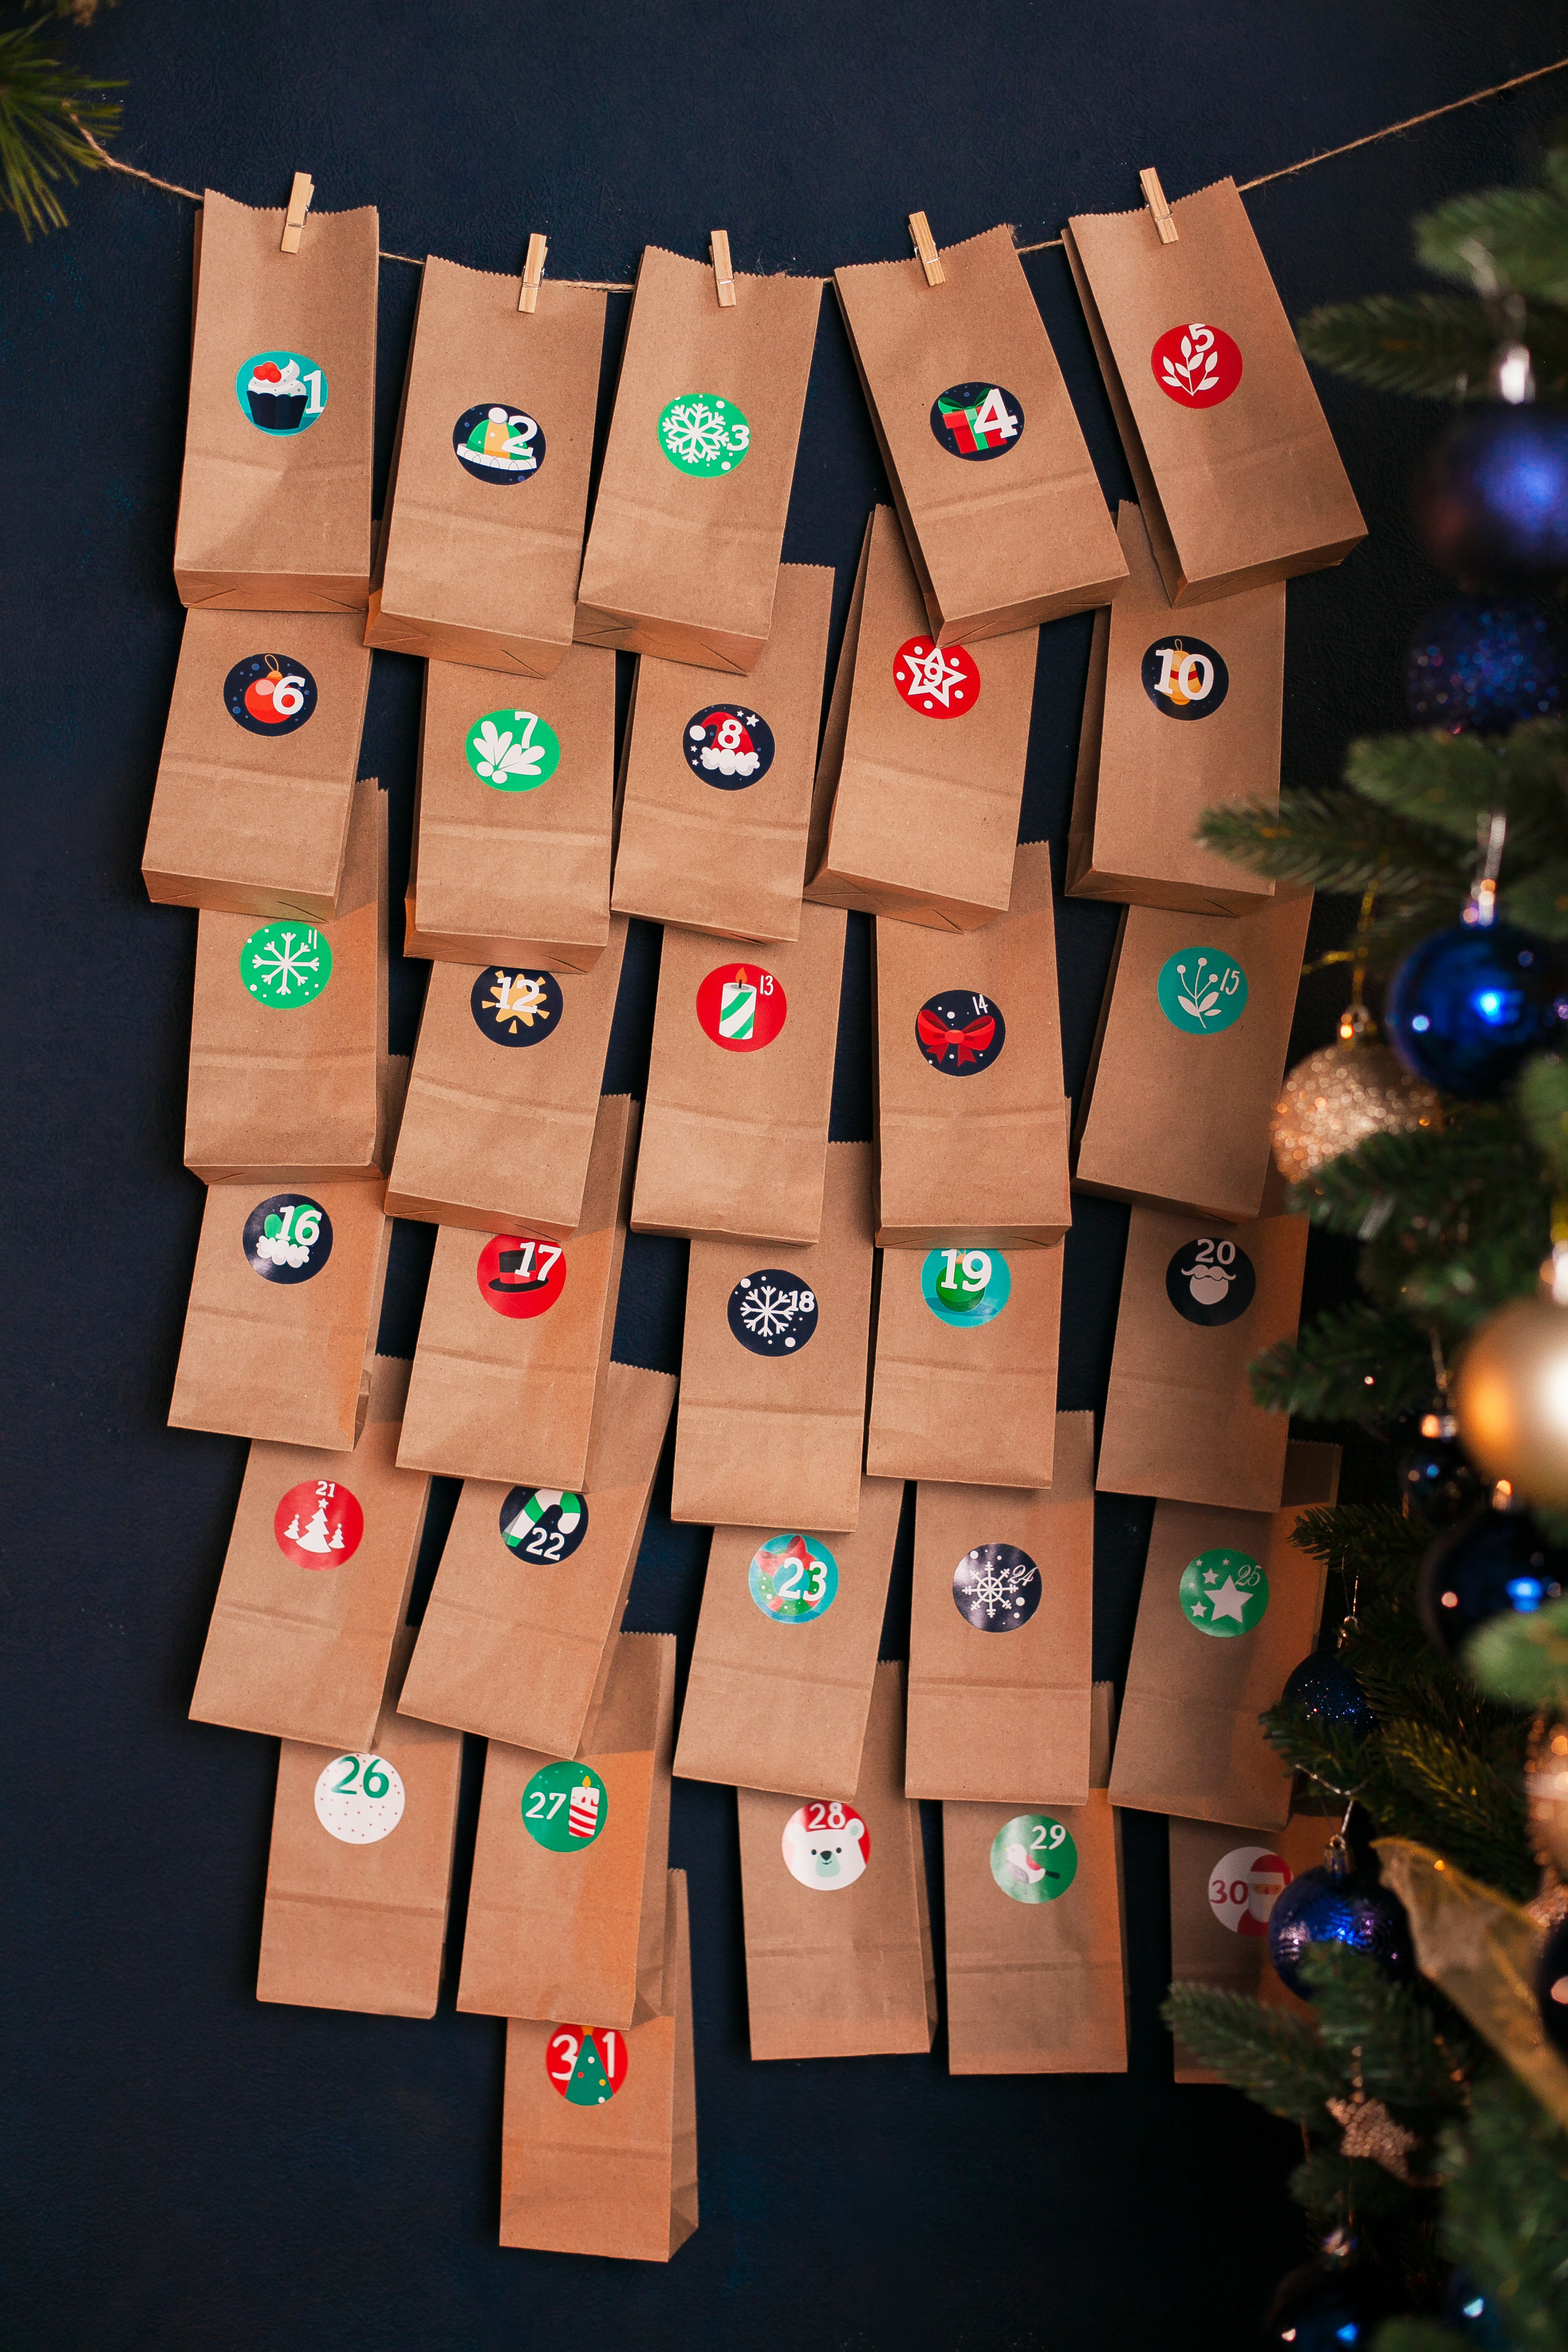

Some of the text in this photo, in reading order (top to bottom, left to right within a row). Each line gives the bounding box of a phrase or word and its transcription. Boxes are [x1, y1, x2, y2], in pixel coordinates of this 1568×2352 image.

[1188, 323, 1214, 353] 5
[303, 370, 325, 414] 1
[973, 389, 1018, 439] 4
[501, 415, 537, 457] 2
[727, 424, 750, 451] 3
[924, 662, 943, 686] 9
[1155, 649, 1214, 700] 10
[273, 676, 305, 715] 6
[514, 712, 538, 748] 7
[717, 719, 742, 749] 8
[495, 977, 540, 1013] 12
[760, 975, 774, 995] 13
[1220, 968, 1240, 995] 15
[972, 994, 988, 1015] 14
[276, 1205, 322, 1245] 16
[514, 1242, 562, 1281] 17
[1195, 1239, 1235, 1265] 20
[941, 1249, 992, 1292] 19
[789, 1291, 814, 1312] 18
[315, 1480, 336, 1498] 21
[526, 1527, 565, 1561] 22
[778, 1557, 827, 1600] 23
[1008, 1565, 1038, 1586] 24
[1235, 1565, 1261, 1586] 25
[331, 1755, 389, 1798] 26
[526, 1792, 567, 1819] 27
[809, 1802, 845, 1829] 28
[1030, 1824, 1066, 1850] 29
[1211, 1880, 1248, 1905] 30
